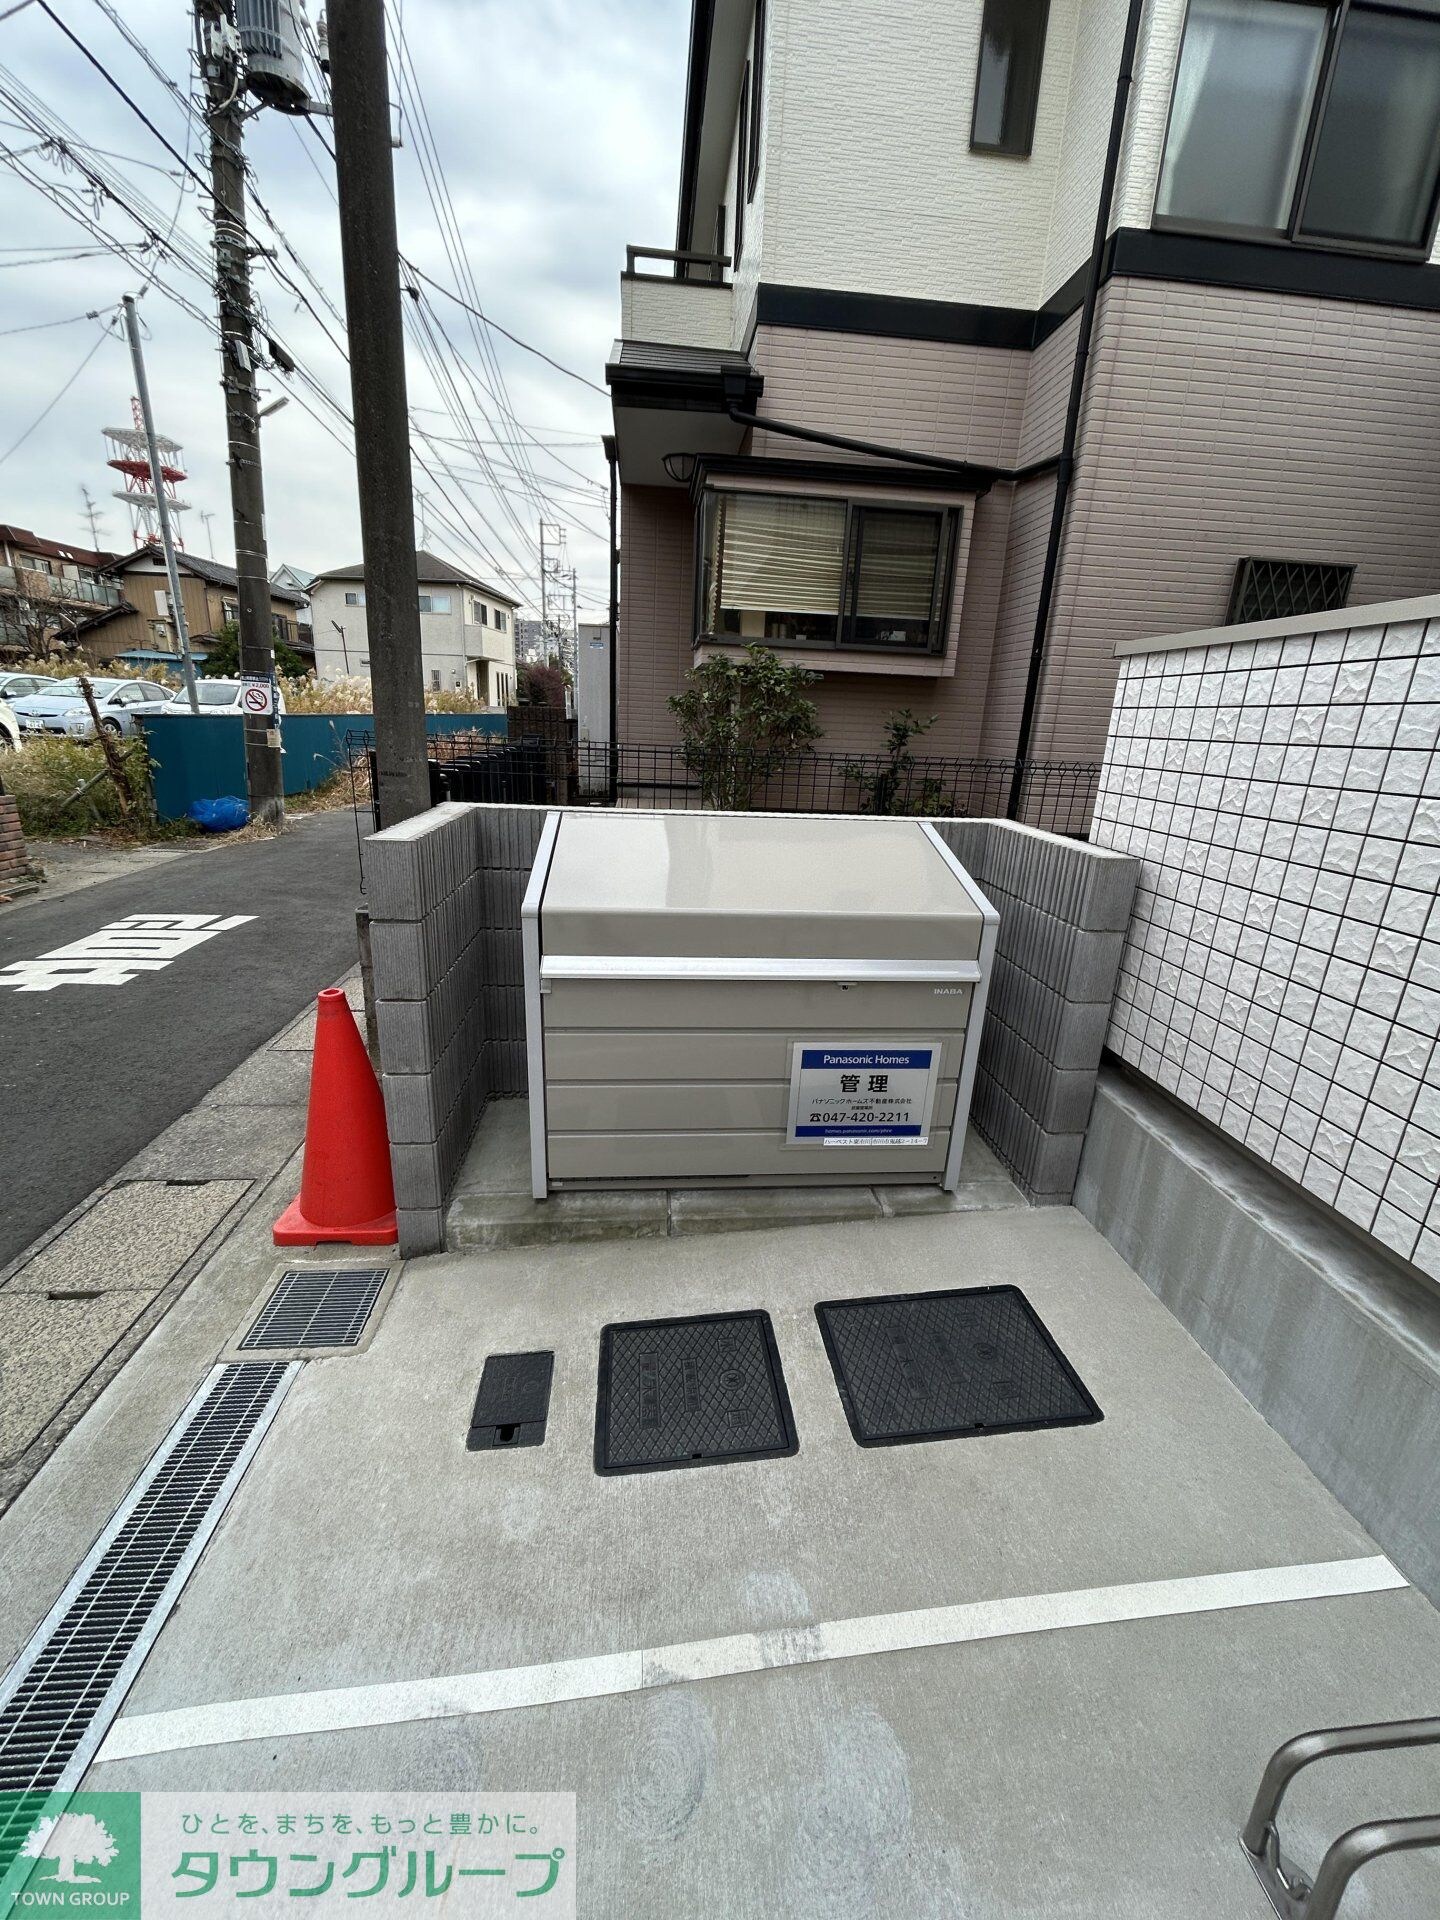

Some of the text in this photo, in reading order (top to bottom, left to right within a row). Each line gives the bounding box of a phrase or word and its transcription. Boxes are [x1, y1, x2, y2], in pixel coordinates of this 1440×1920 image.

[823, 1055, 910, 1064] Panasonic Homes
[840, 1074, 889, 1093] 管理
[822, 1112, 910, 1123] 047-420-2211
